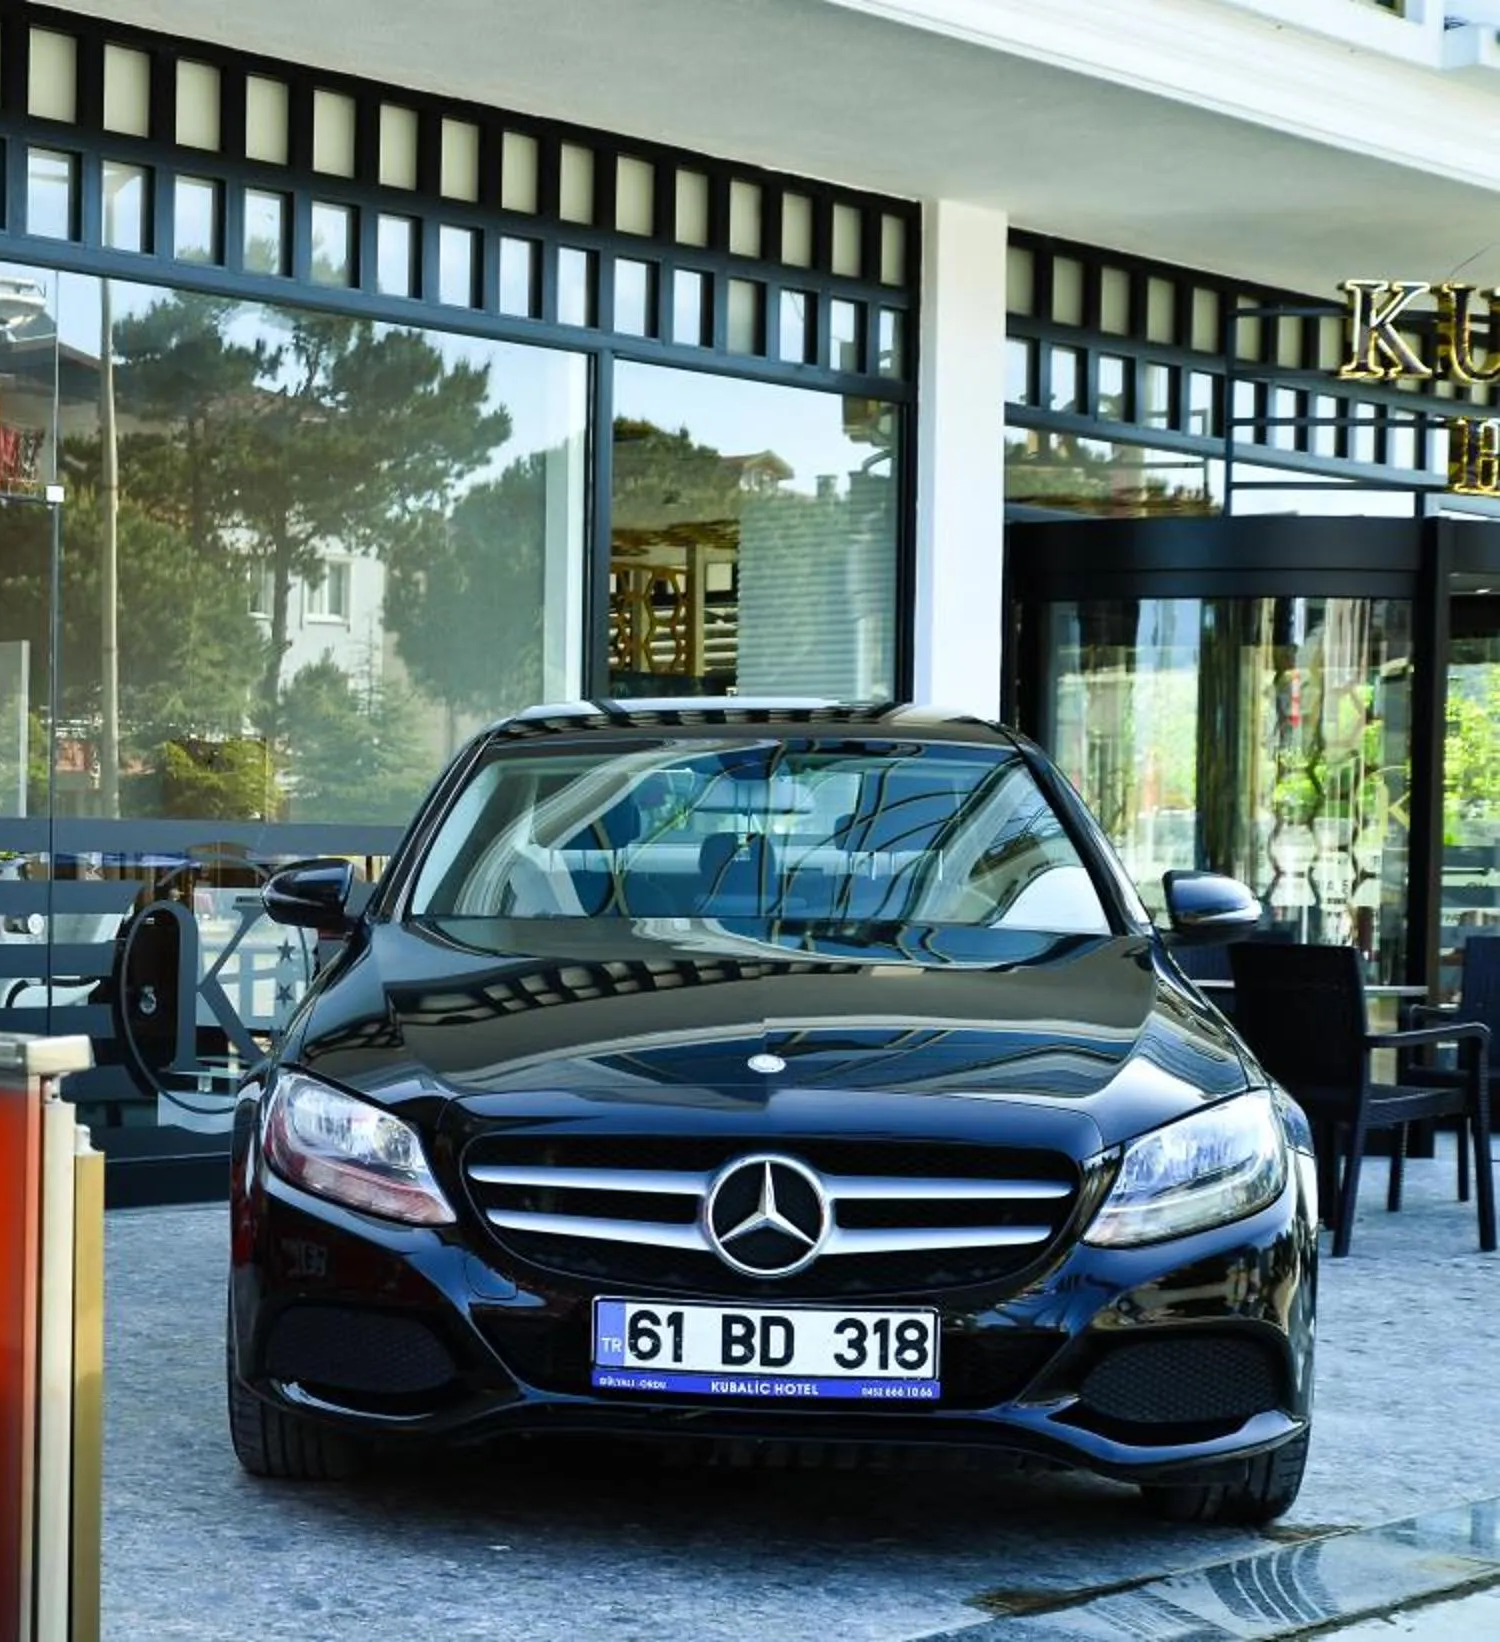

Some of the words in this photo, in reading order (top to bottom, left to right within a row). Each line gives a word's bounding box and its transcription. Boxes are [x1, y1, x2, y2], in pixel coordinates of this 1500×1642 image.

[601, 1337, 622, 1353] TR
[628, 1309, 684, 1363] 61
[721, 1314, 795, 1367] BD
[833, 1317, 929, 1371] 318
[775, 1383, 819, 1395] HOTEL
[907, 1387, 918, 1397] 10
[920, 1387, 933, 1397] 66
